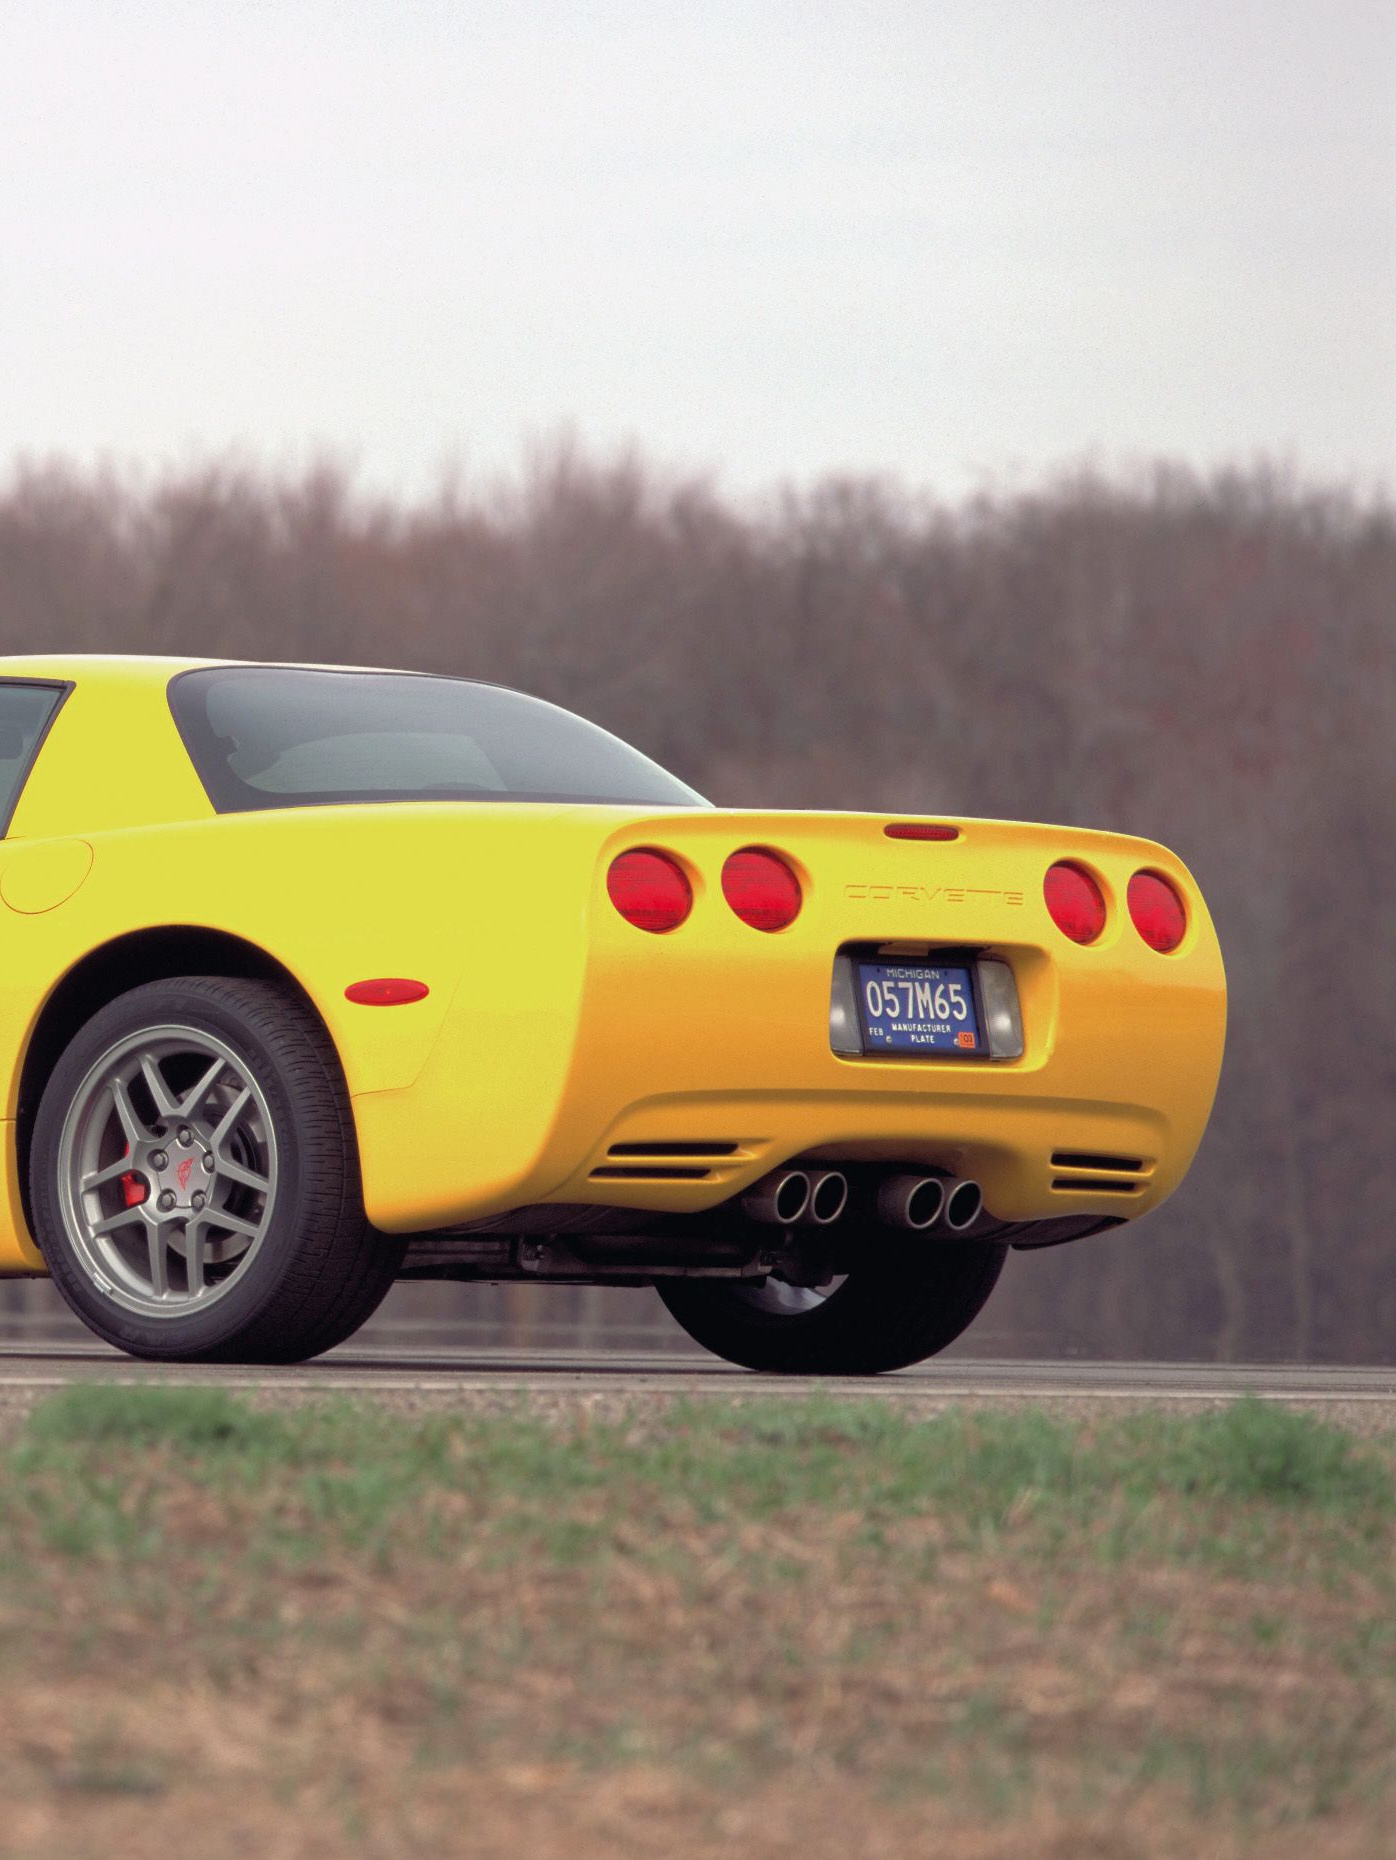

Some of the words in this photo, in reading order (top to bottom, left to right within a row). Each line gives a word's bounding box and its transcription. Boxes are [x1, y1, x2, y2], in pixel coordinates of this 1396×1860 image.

[843, 884, 1024, 906] CORVETTE
[886, 968, 940, 980] MICHIGAN
[866, 981, 967, 1020] 057M65
[869, 1027, 884, 1036] FEB
[891, 1023, 951, 1033] MANUFACTURER
[911, 1034, 936, 1044] PLATE
